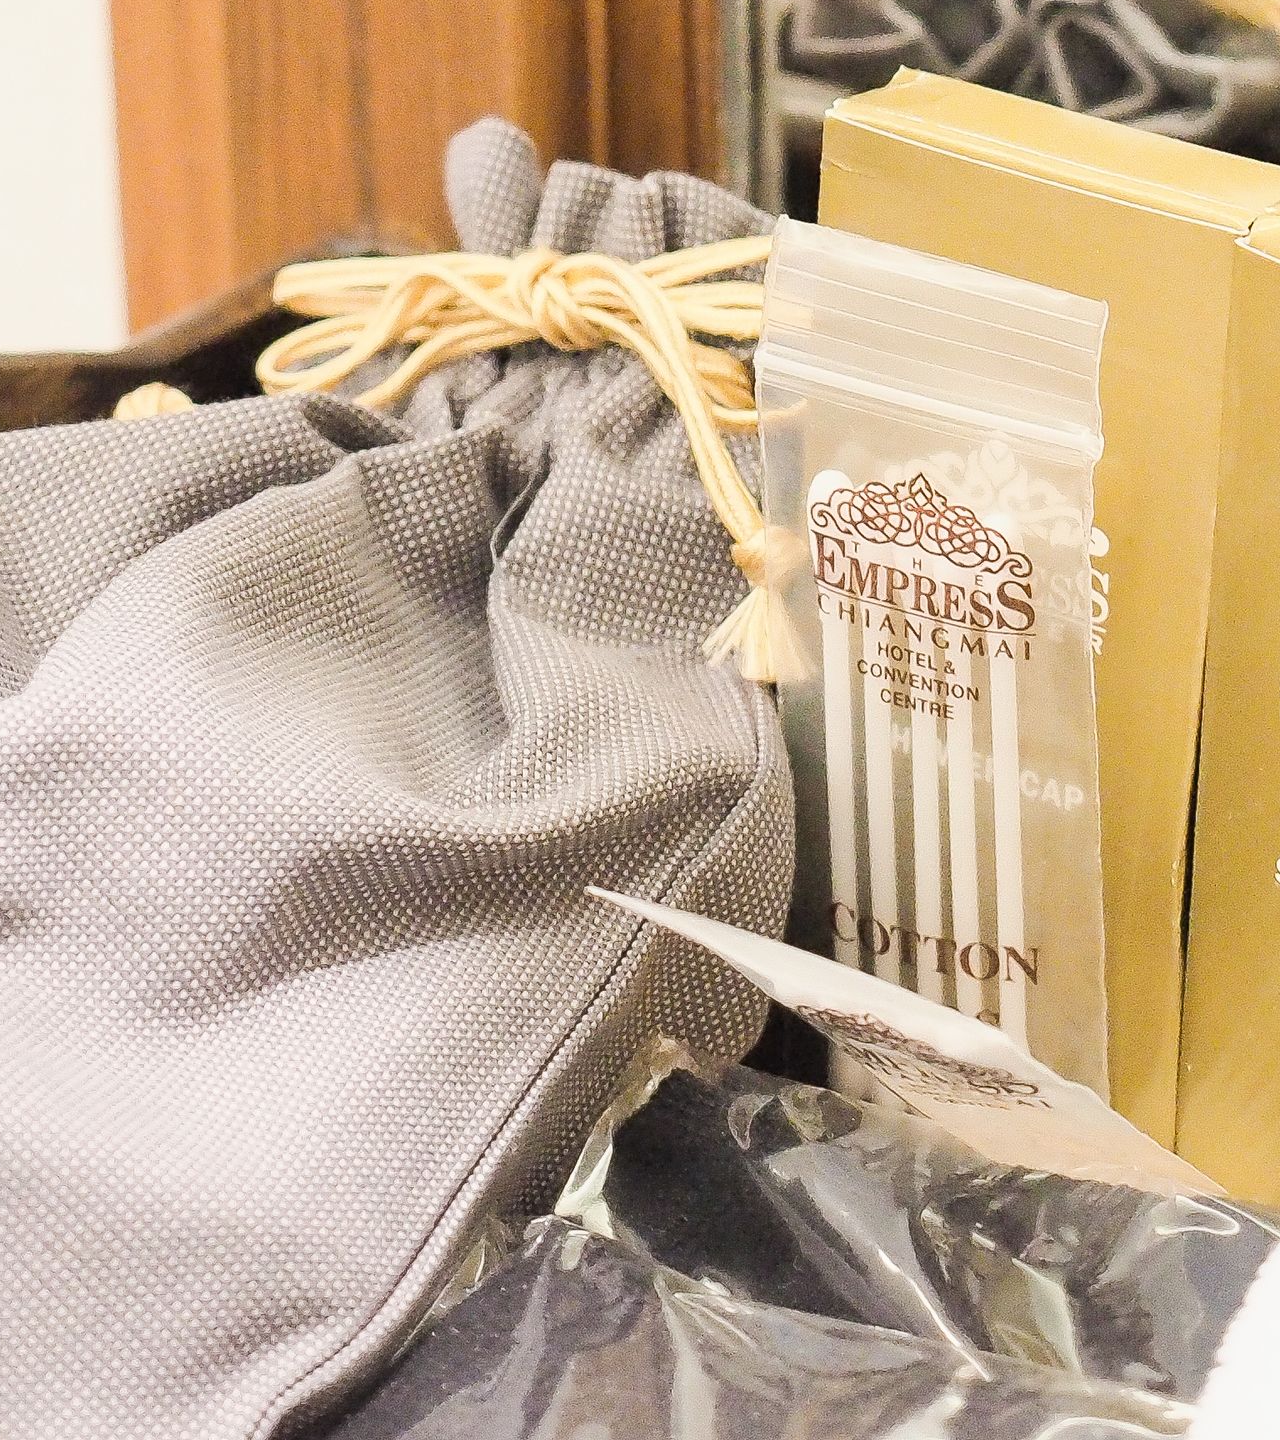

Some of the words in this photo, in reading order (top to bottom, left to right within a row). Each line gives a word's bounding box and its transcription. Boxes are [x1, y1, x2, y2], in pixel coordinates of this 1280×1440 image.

[811, 529, 1036, 632] EMPRESS
[857, 658, 980, 702] CONVENTION
[878, 642, 937, 672] HOTEL
[944, 661, 956, 675] &
[880, 688, 955, 720] CENTRE
[1020, 769, 1085, 811] CAP
[832, 901, 1040, 986] COTTON
